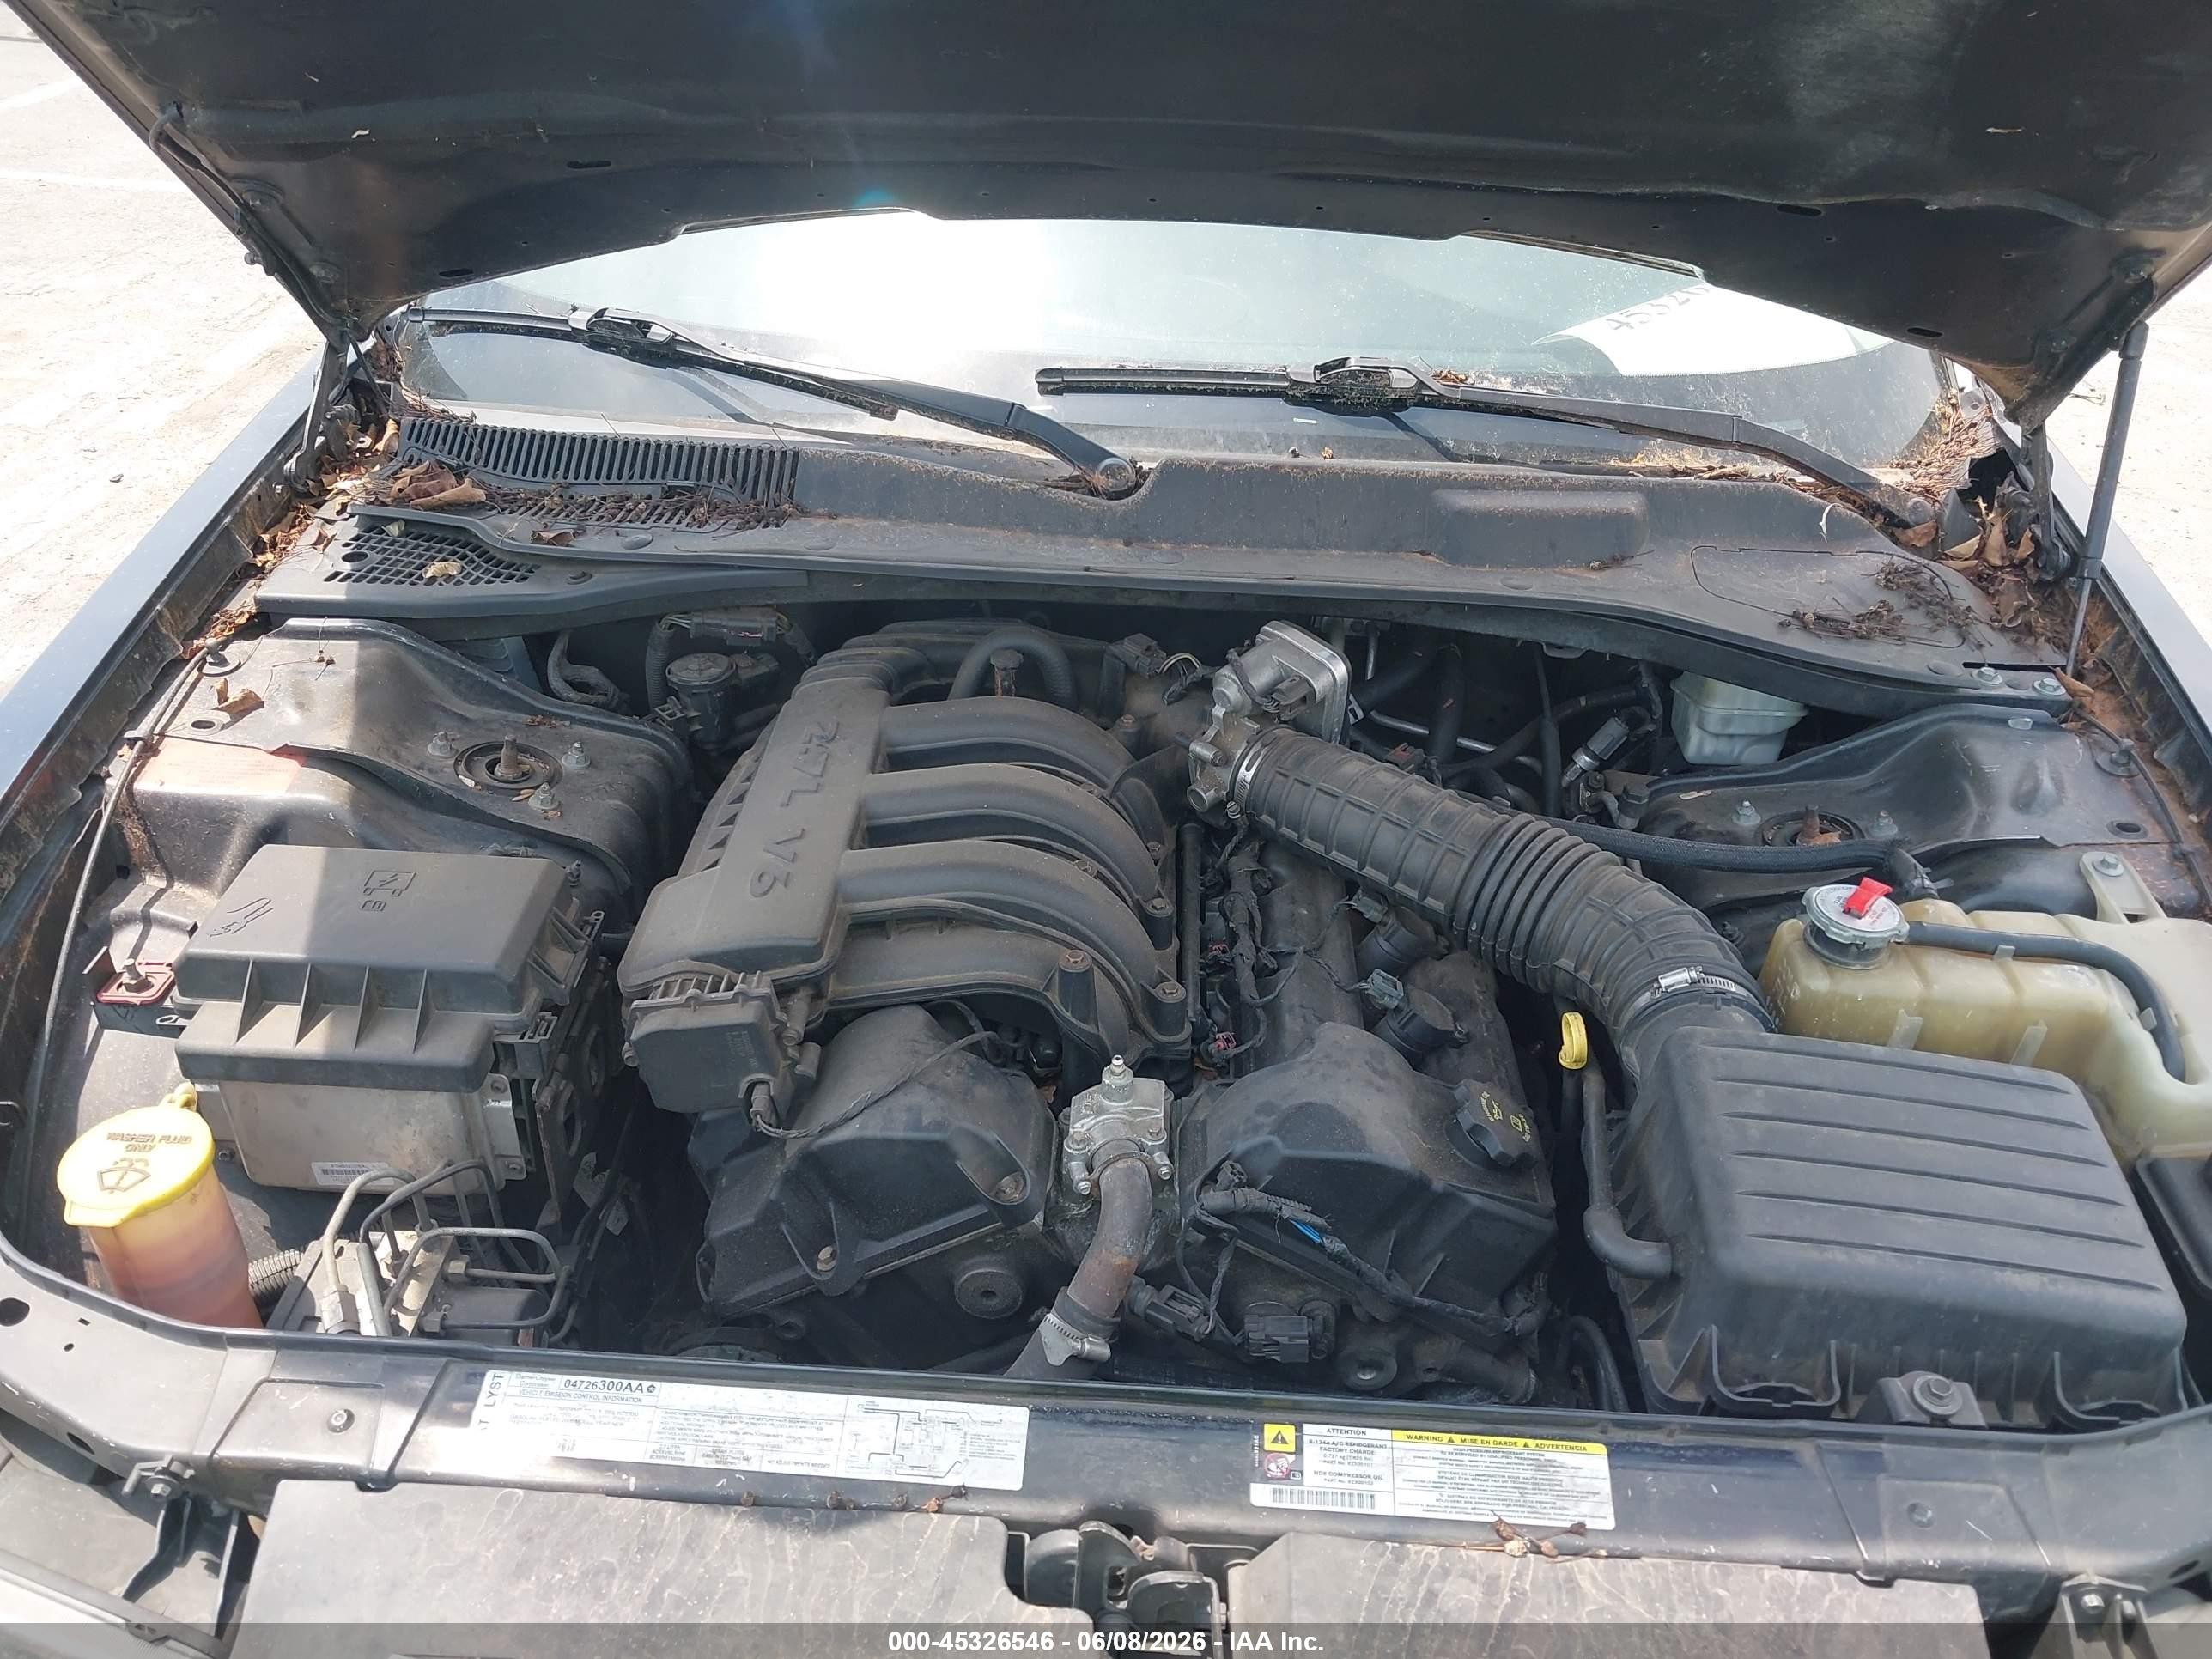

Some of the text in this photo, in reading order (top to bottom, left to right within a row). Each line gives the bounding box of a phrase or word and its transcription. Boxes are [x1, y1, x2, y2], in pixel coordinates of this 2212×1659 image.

[750, 828, 805, 898] V6
[106, 1133, 193, 1144] WASHER FLUID
[125, 1143, 156, 1153] ONLY
[564, 1379, 644, 1394] 04726300AA
[544, 1389, 572, 1398] EMISSION
[573, 1392, 601, 1401] CONTROL
[602, 1395, 642, 1403] INFORMATION
[1407, 1434, 1443, 1443] WARNING
[1534, 1443, 1588, 1451] ADVERTENCIA
